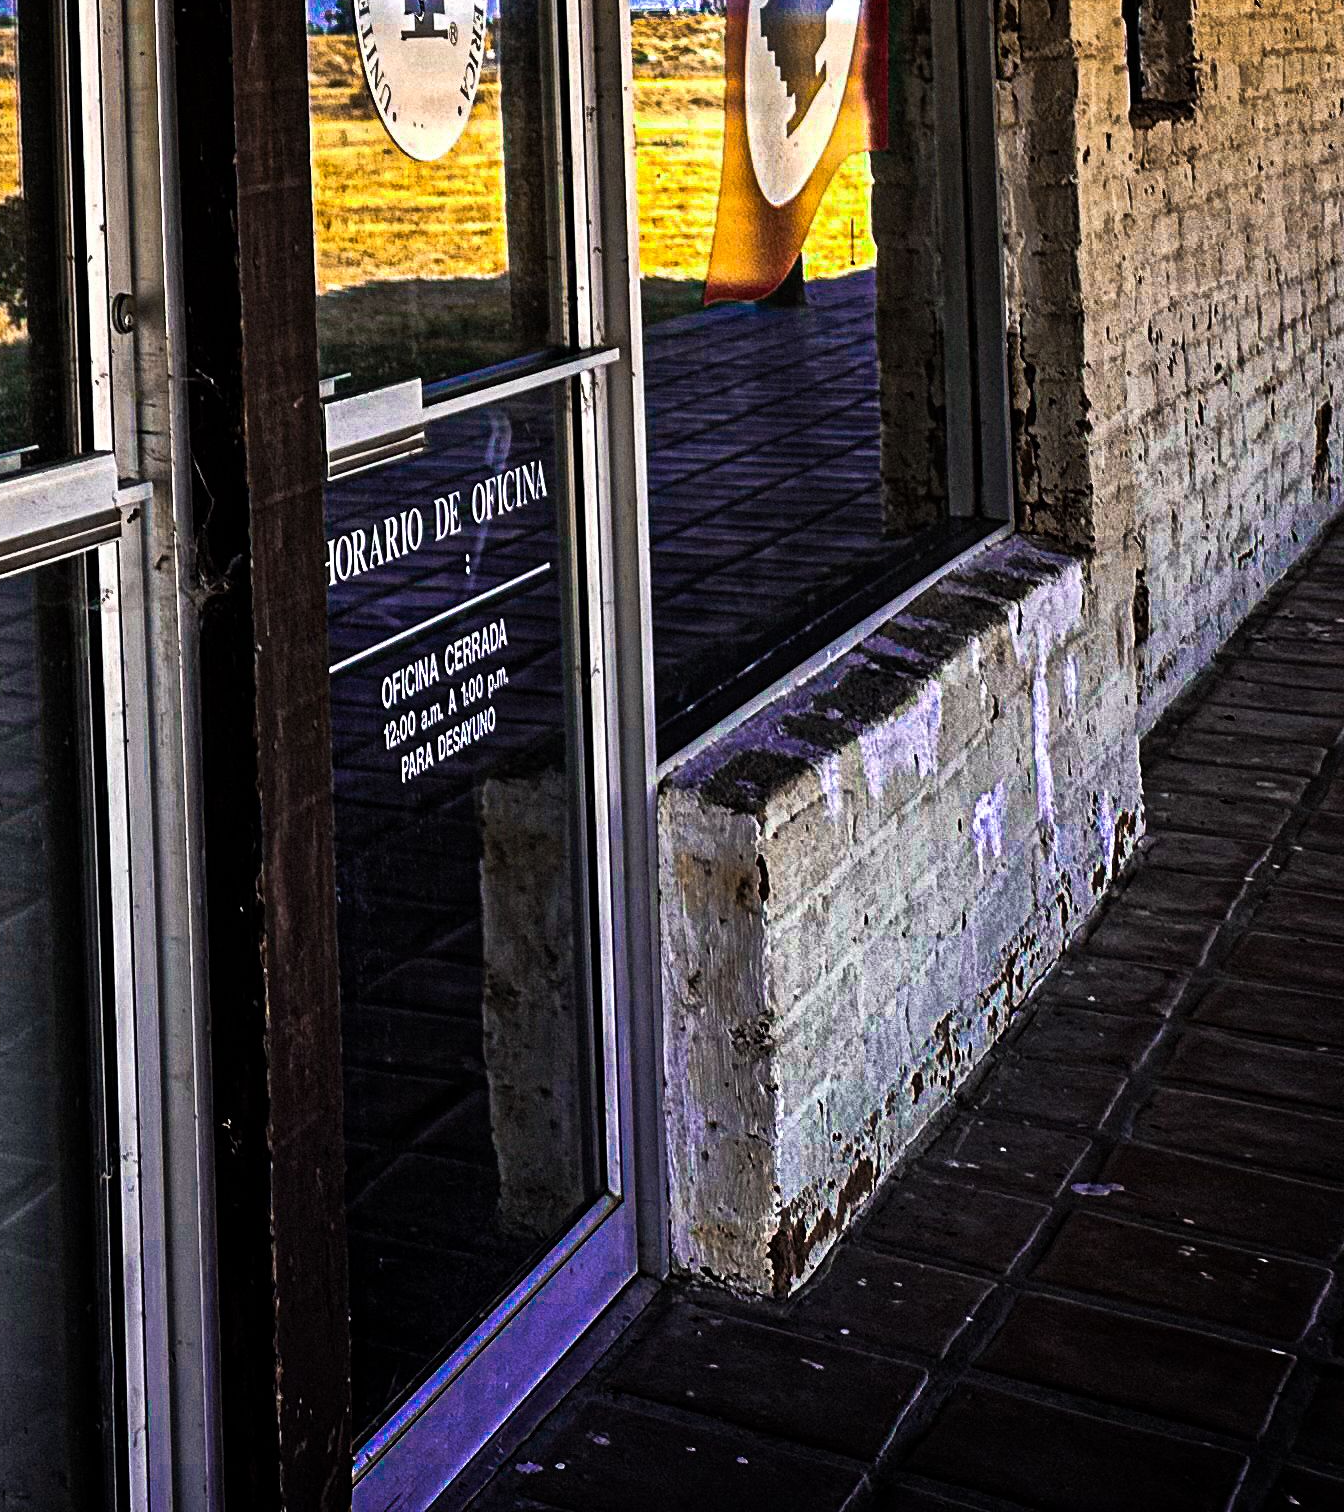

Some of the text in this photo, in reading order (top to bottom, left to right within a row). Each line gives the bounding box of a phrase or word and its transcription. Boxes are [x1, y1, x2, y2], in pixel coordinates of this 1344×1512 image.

[434, 491, 461, 541] DE
[472, 460, 548, 524] OFICINA
[381, 618, 508, 709] OFICINA CERRADA
[384, 667, 509, 750] 12:00 a.m. A 1:00 p.m.
[401, 706, 496, 784] PARA DESAYUNO
